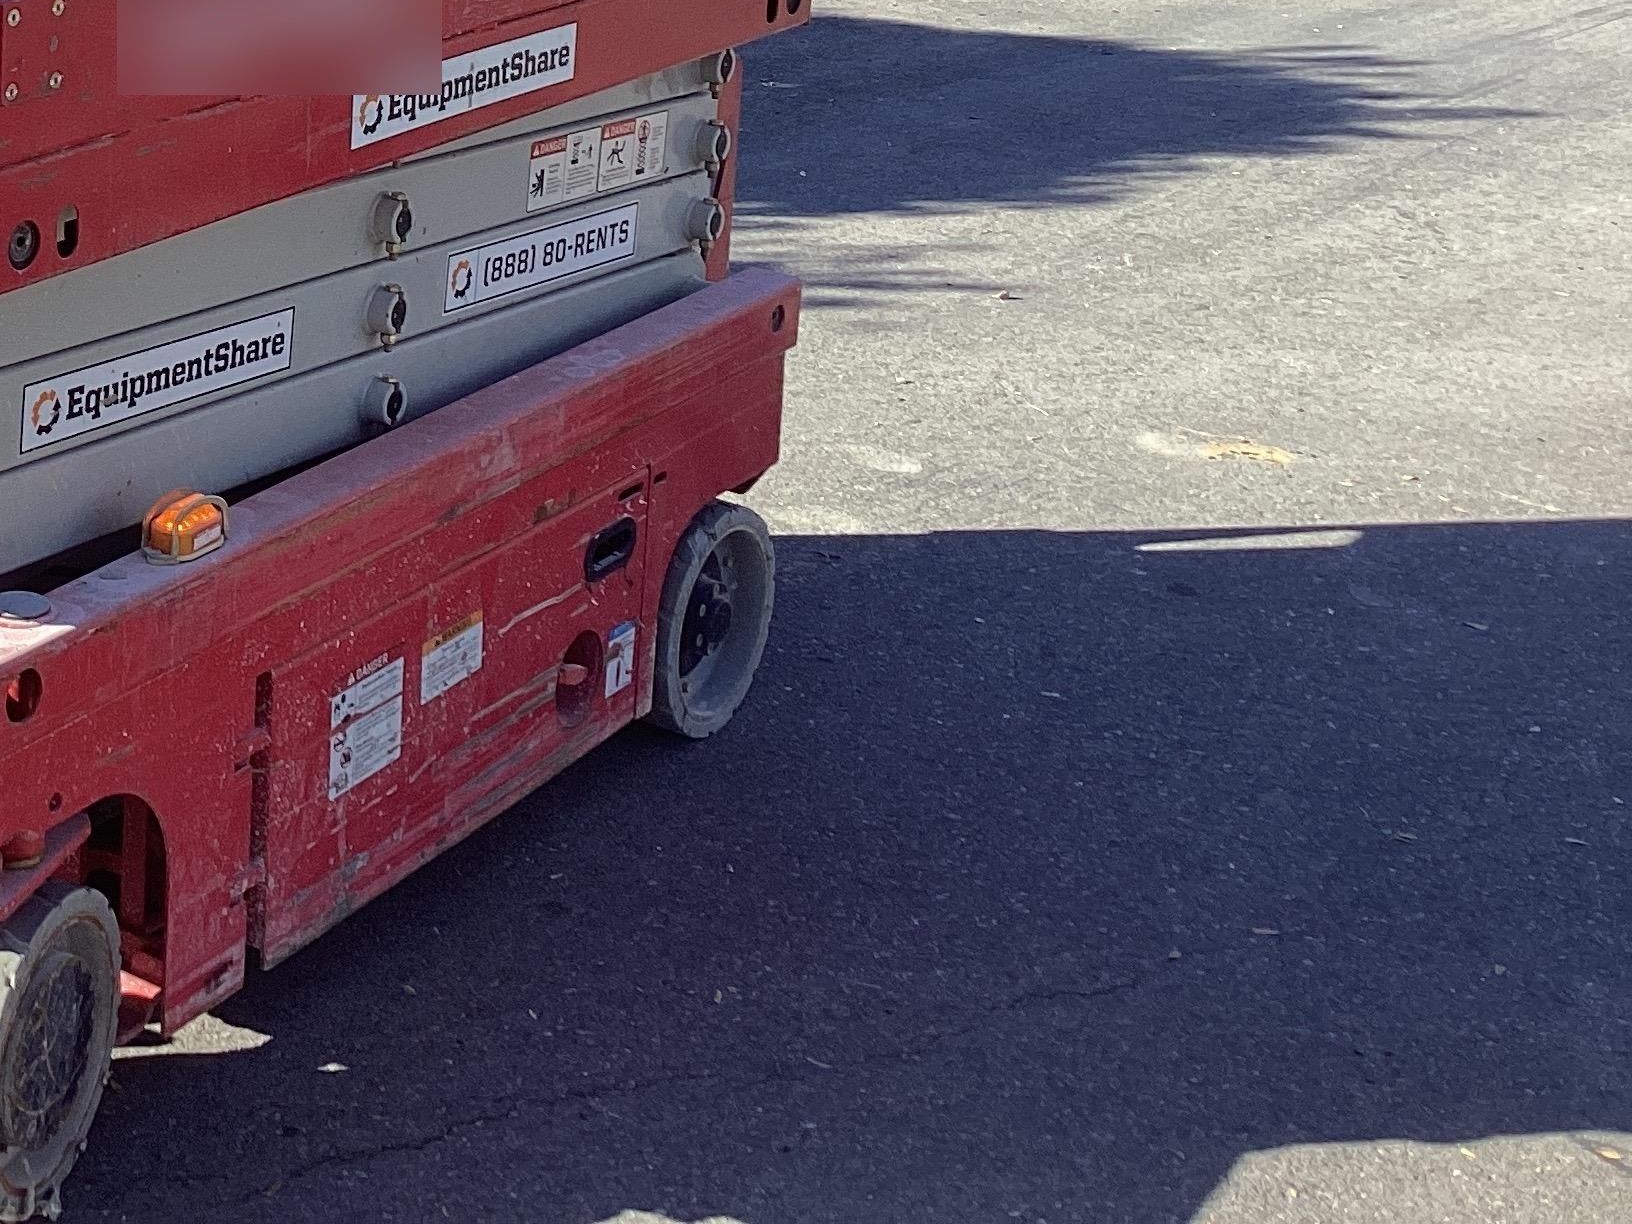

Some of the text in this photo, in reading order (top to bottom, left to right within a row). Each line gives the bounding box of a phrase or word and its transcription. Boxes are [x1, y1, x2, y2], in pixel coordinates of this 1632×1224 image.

[539, 136, 567, 156] DANGER
[483, 218, 631, 289] (888) 80-RENTS
[66, 331, 286, 420] EquipmentShare
